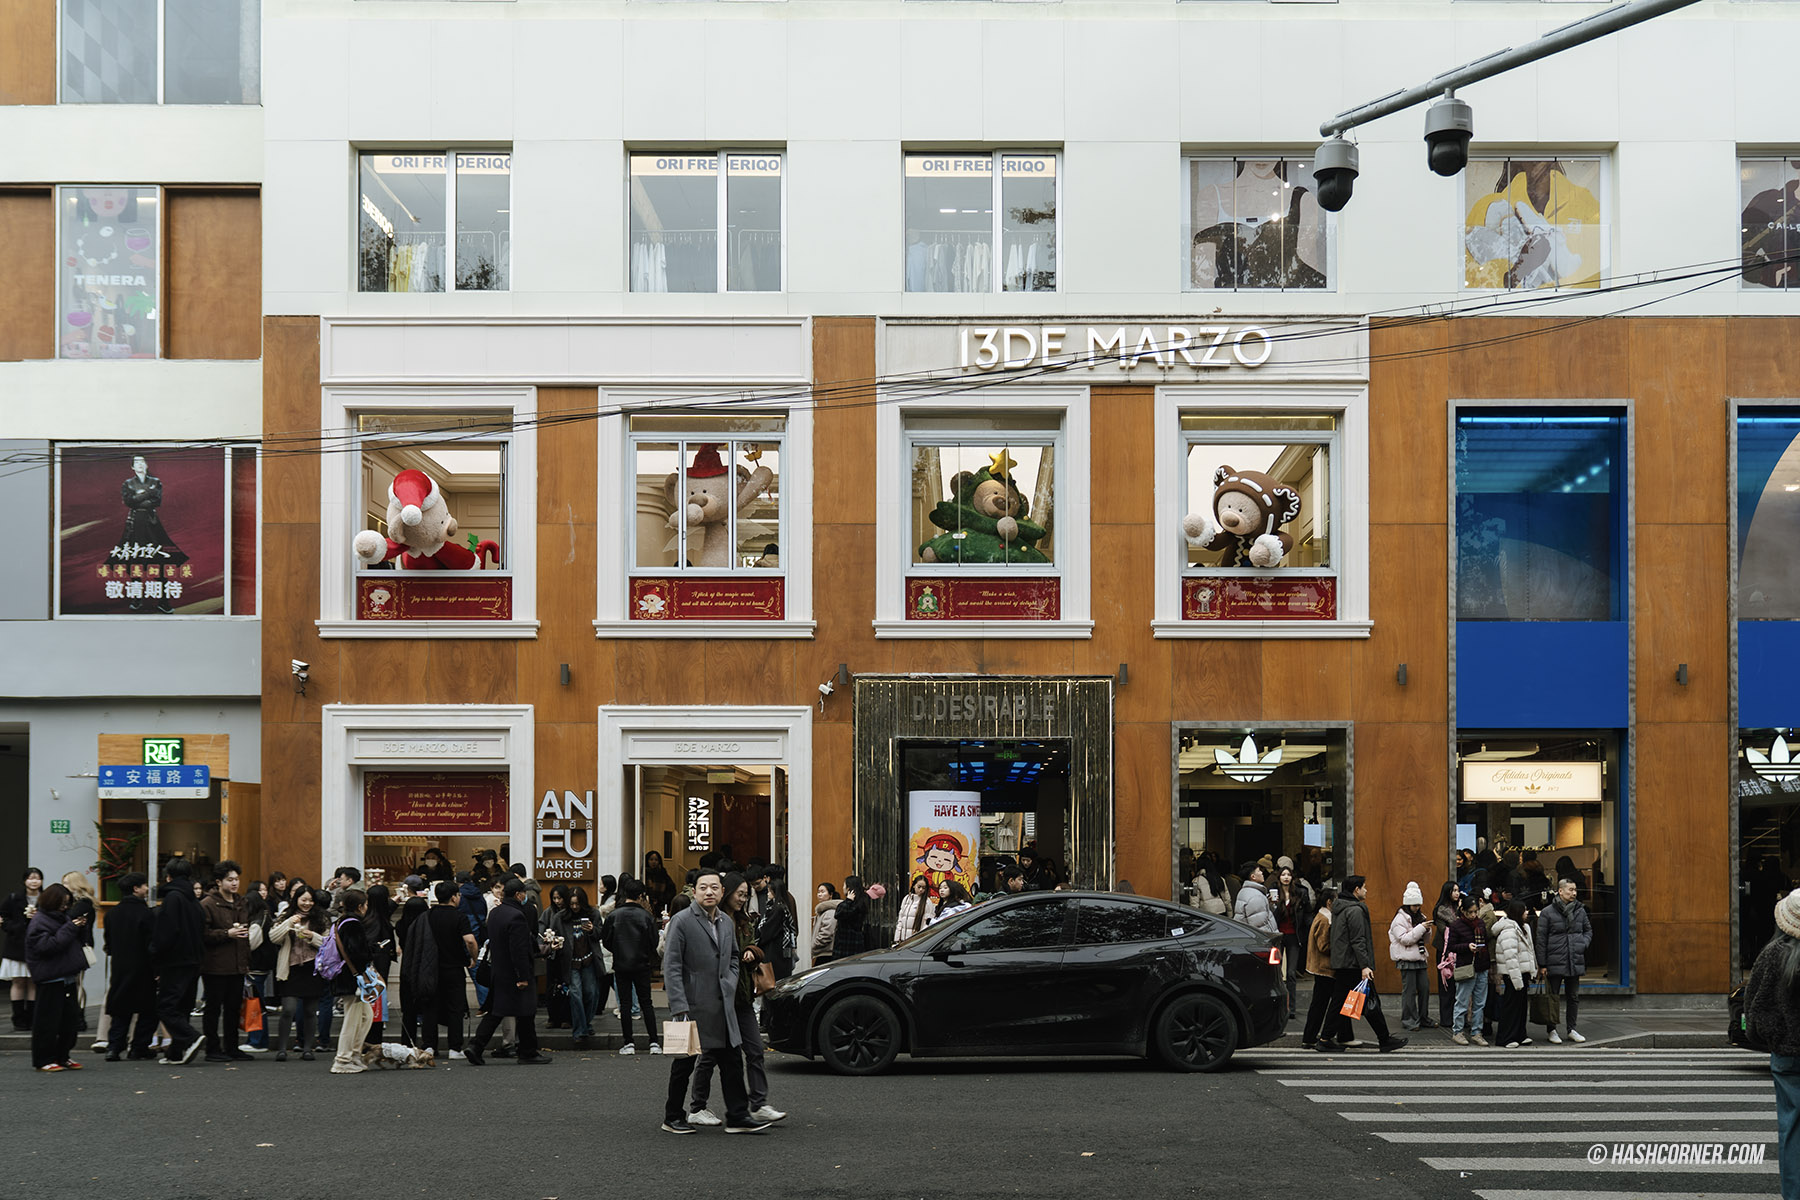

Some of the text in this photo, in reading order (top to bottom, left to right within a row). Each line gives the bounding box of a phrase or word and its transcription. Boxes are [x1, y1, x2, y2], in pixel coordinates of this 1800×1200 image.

[391, 157, 419, 168] ORI
[656, 159, 779, 171] ORI FREERIQO
[922, 160, 949, 171] ORI
[74, 275, 146, 286] TENERA
[961, 325, 1273, 370] 13DE MARZO
[105, 581, 183, 599] 敬请期待
[912, 695, 1056, 721] D.DESIRABLE
[408, 743, 448, 753] MARZO
[700, 743, 741, 752] MARZO
[126, 769, 181, 785] 安福路
[194, 769, 203, 778] 东
[1491, 768, 1573, 783] Adidas Originals
[536, 790, 593, 819] AN
[934, 804, 958, 817] HAVE
[960, 804, 966, 817] A
[688, 797, 697, 845] MARKET
[697, 797, 710, 845] ANFU
[536, 829, 593, 858] FU
[536, 860, 592, 869] MARKET
